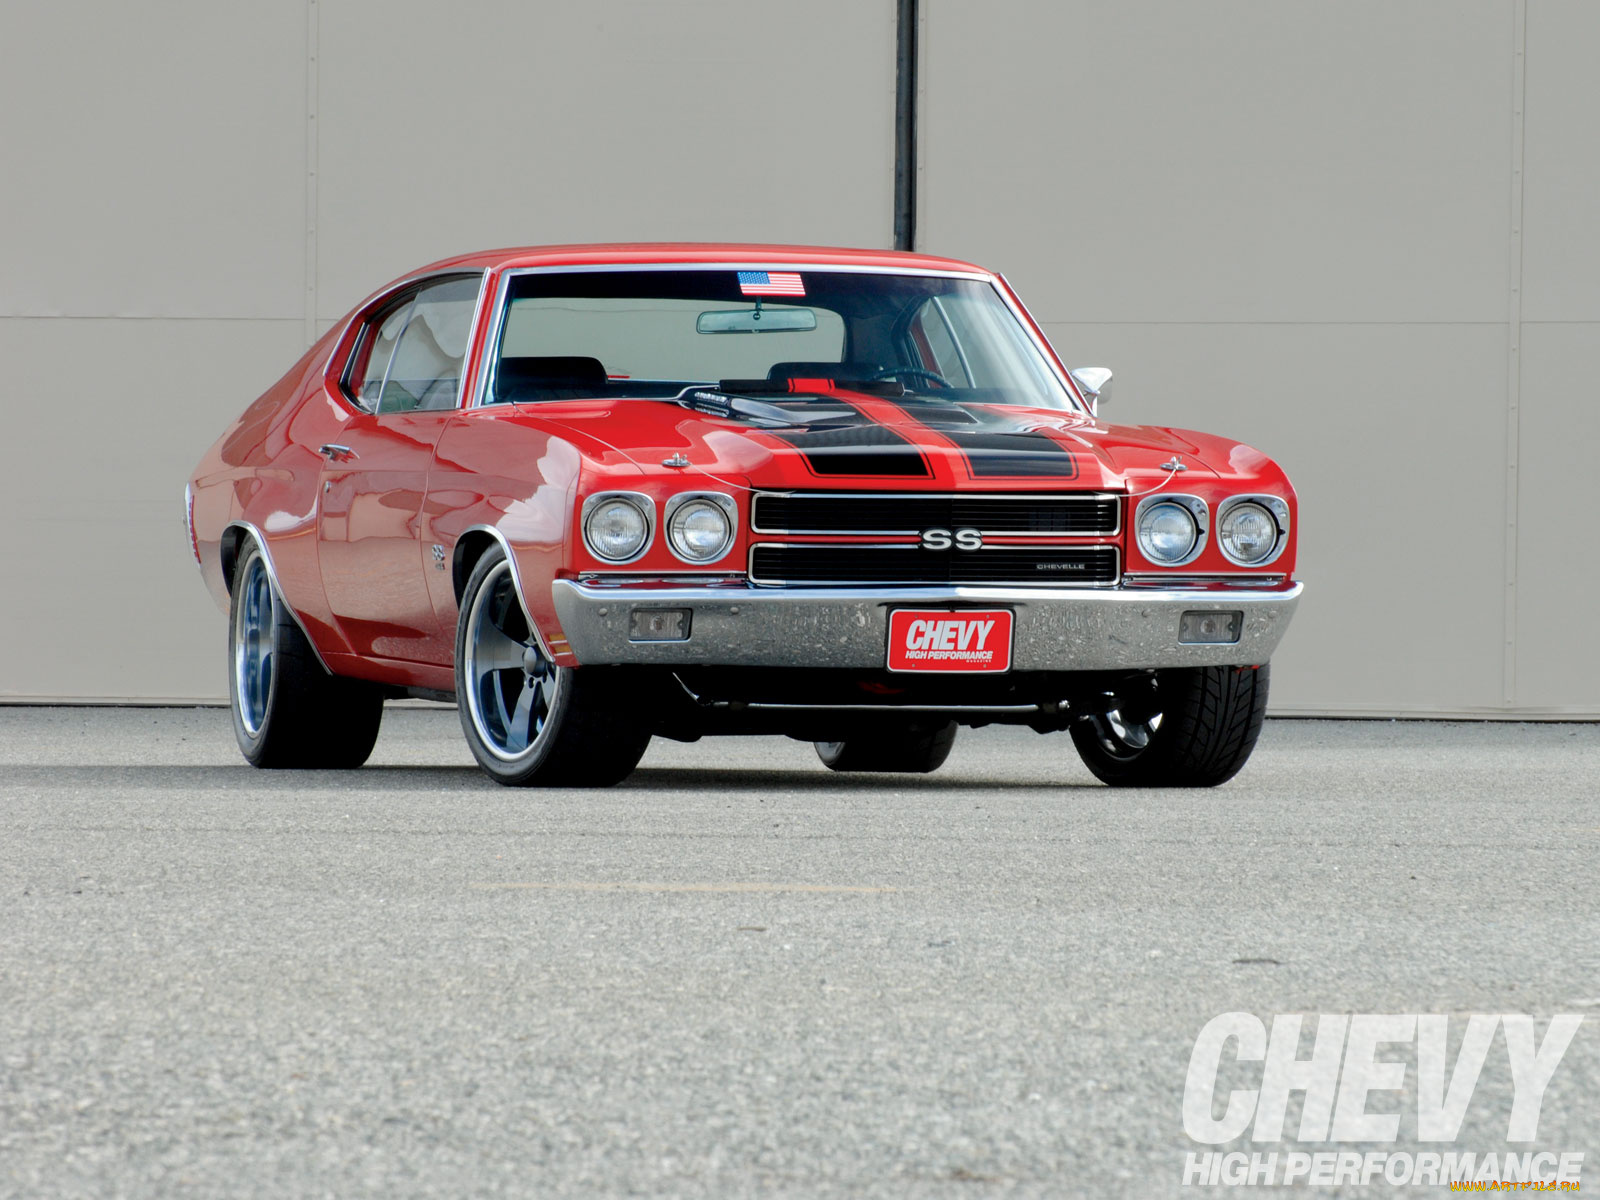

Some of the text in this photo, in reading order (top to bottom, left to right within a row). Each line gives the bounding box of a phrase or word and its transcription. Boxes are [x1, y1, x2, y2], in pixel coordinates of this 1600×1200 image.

[921, 528, 983, 550] SS
[905, 620, 995, 650] CHEVY
[905, 650, 993, 660] HIGH PERFORMANCE
